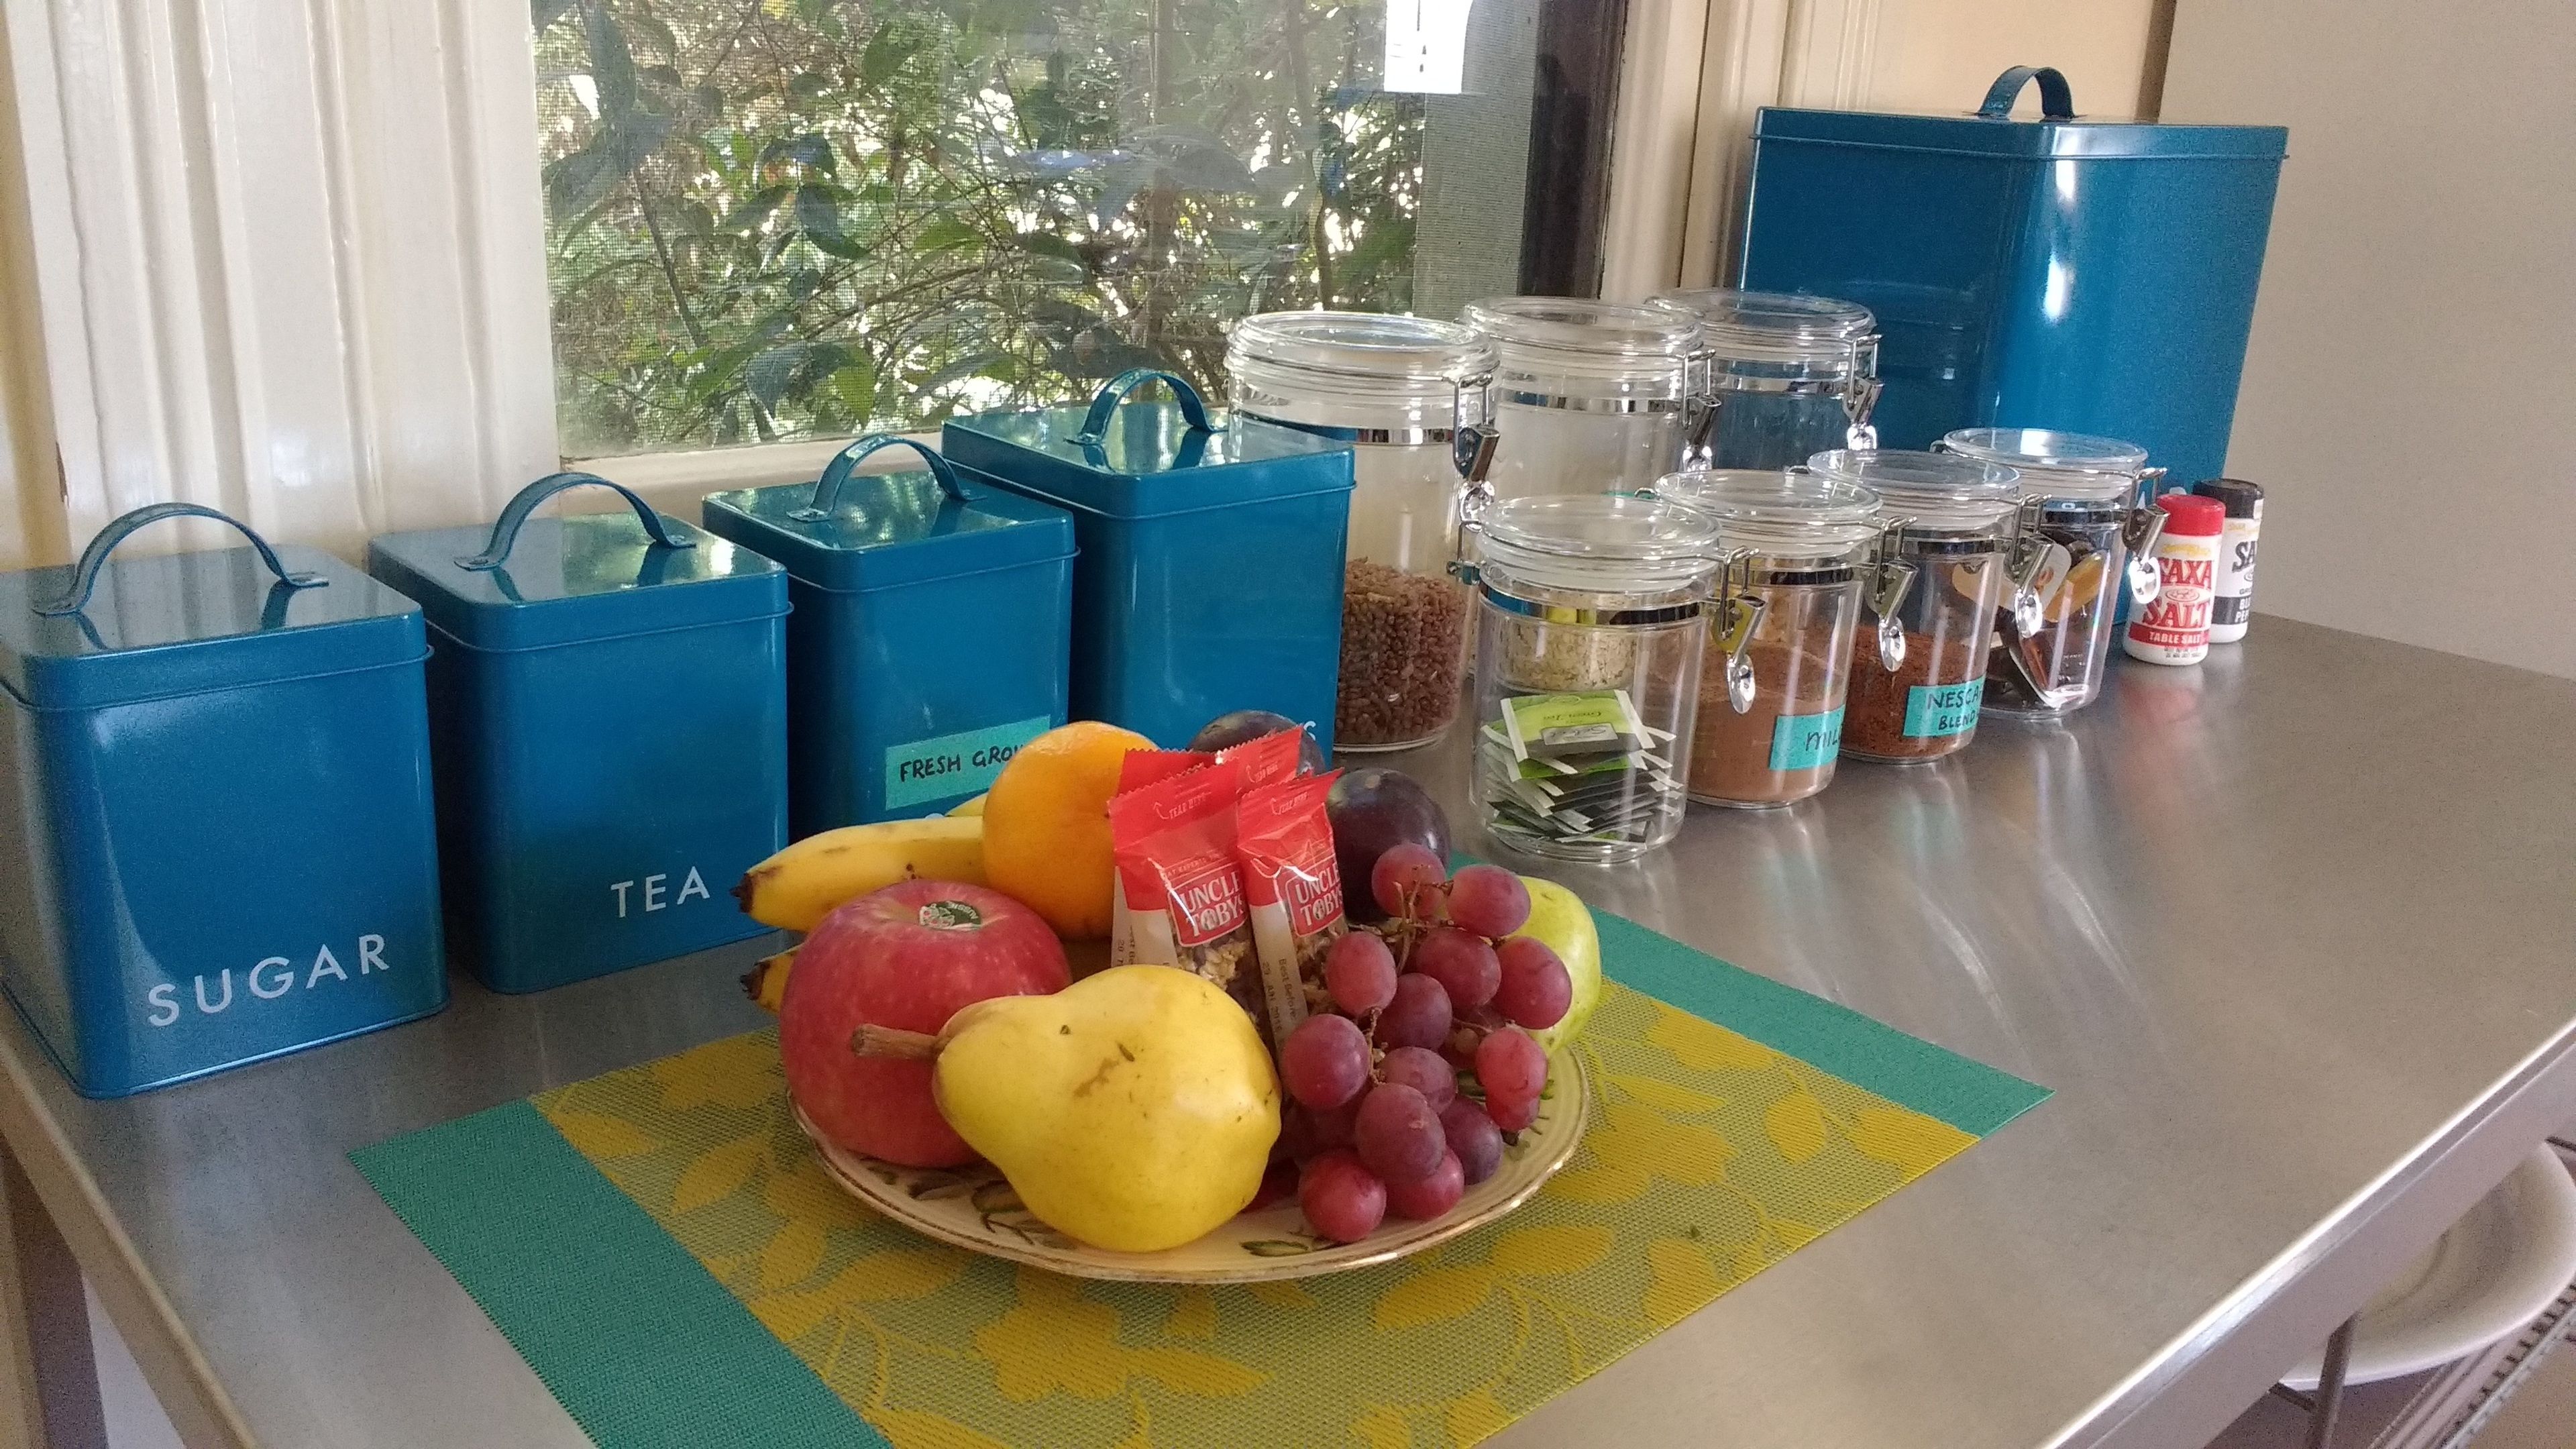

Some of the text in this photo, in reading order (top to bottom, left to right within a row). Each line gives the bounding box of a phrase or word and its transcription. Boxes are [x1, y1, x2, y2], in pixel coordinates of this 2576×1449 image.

[2143, 596, 2210, 628] SALT
[2149, 631, 2201, 644] TABLE SALT
[1927, 686, 1982, 710] NESCA
[1938, 710, 1976, 731] BLEND
[900, 753, 961, 782] FRESH
[610, 866, 710, 918] TEA
[1295, 862, 1340, 904] UNCLE
[148, 933, 389, 1027] SUGAR
[1279, 959, 1289, 982] Best
